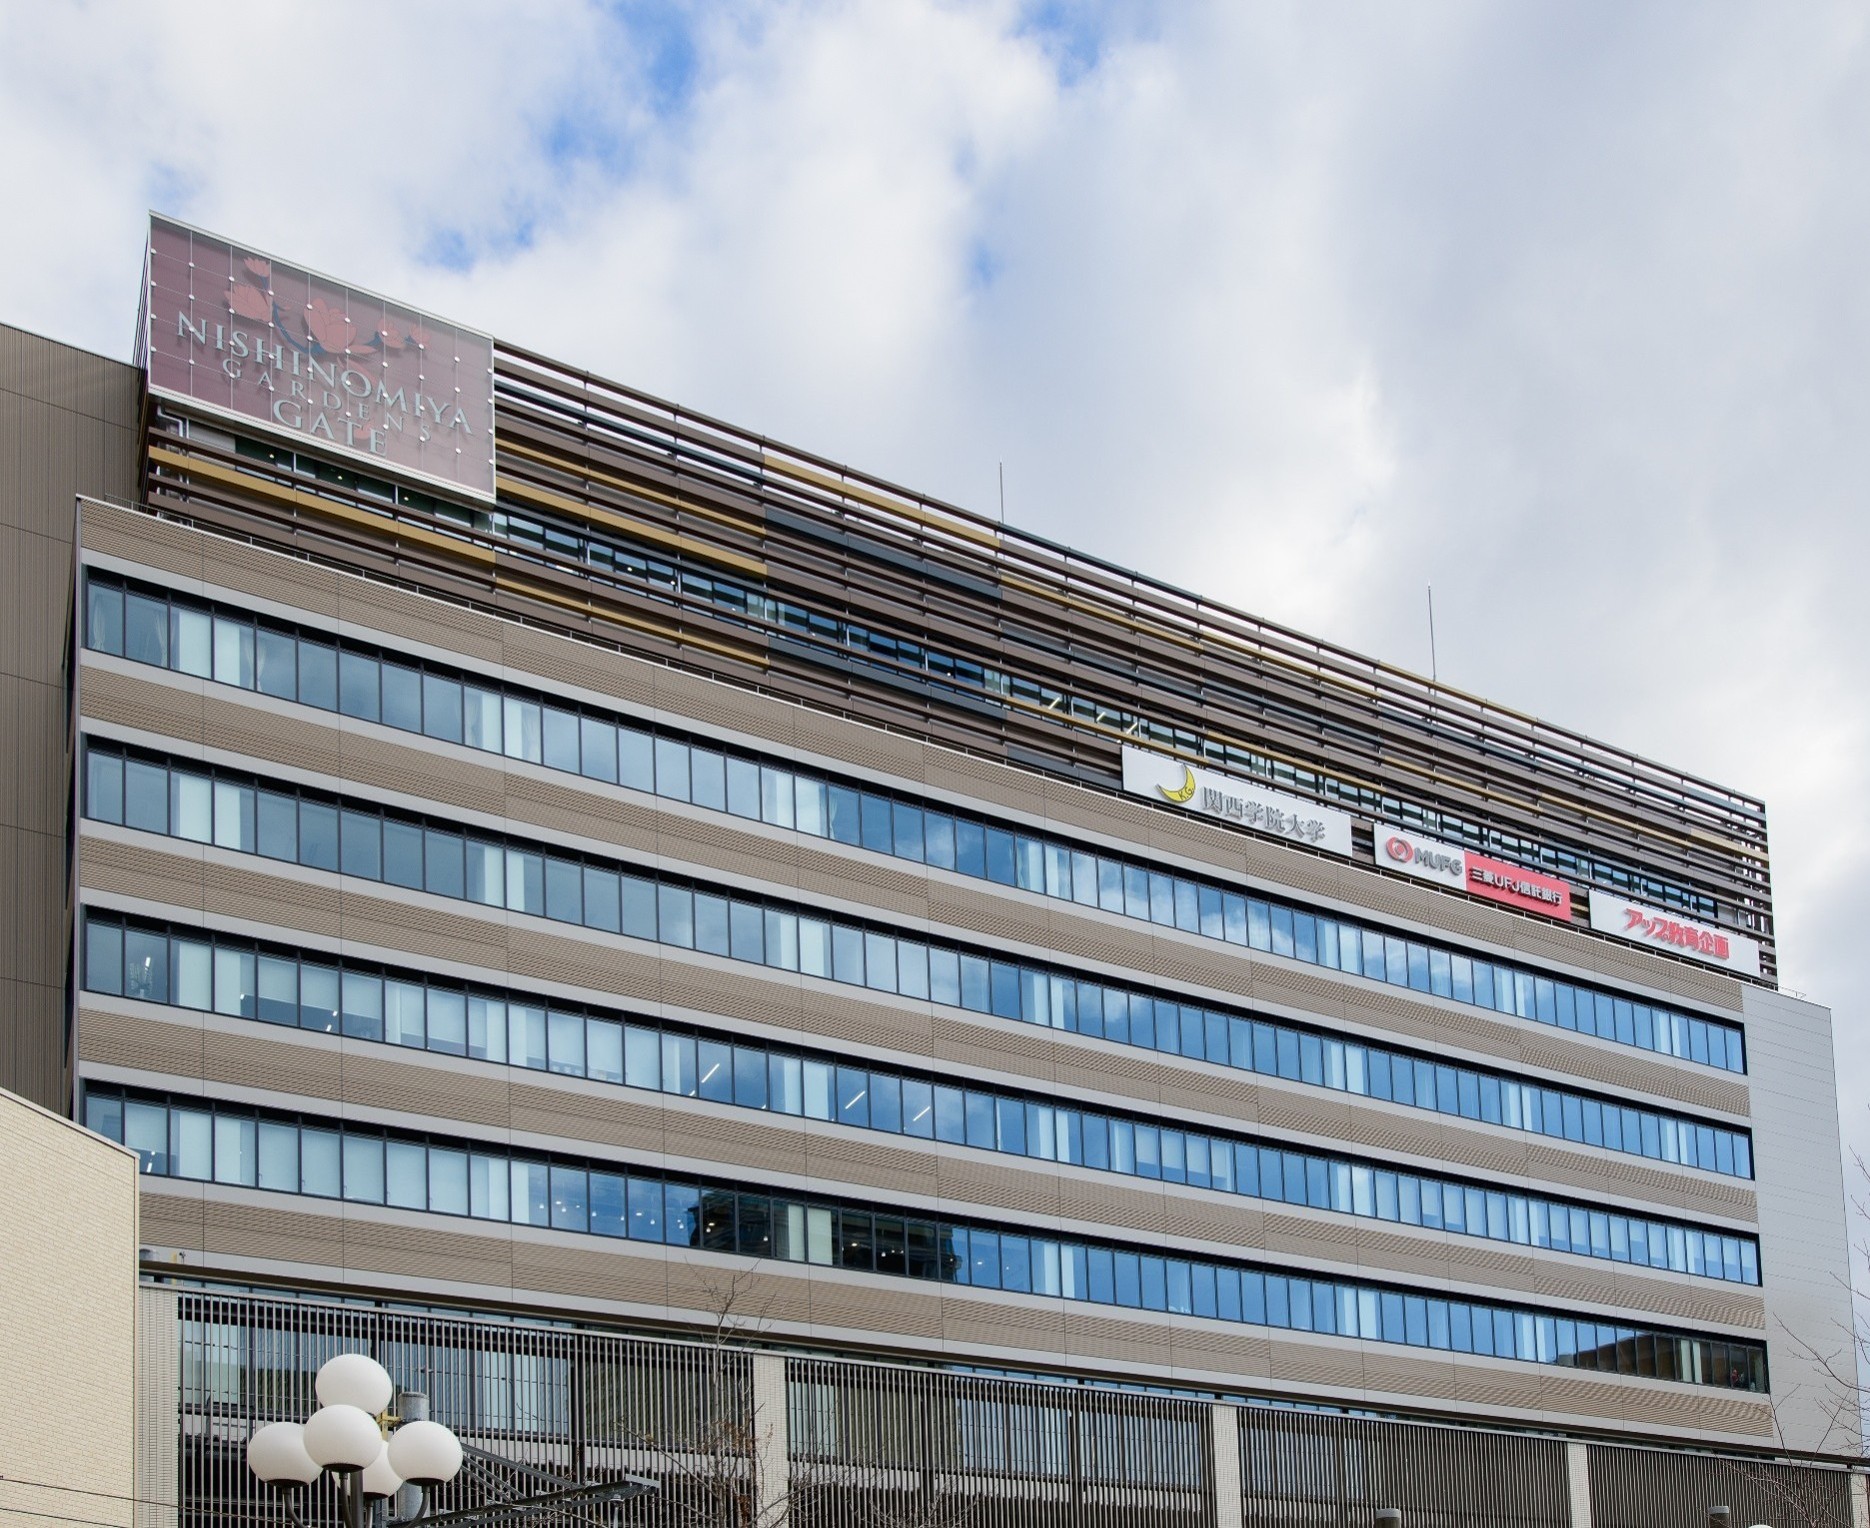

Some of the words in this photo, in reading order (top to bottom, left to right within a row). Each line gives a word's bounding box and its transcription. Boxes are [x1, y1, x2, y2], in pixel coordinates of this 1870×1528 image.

[177, 311, 473, 434] NISHINOMIYA
[222, 359, 432, 442] GARDENS
[272, 399, 387, 455] GATE
[1202, 787, 1326, 842] 関西学院大学
[1415, 848, 1463, 876] MUFG
[1470, 867, 1563, 905] 三菱UFJ信託銀行
[1625, 908, 1730, 959] アップ教育企画
